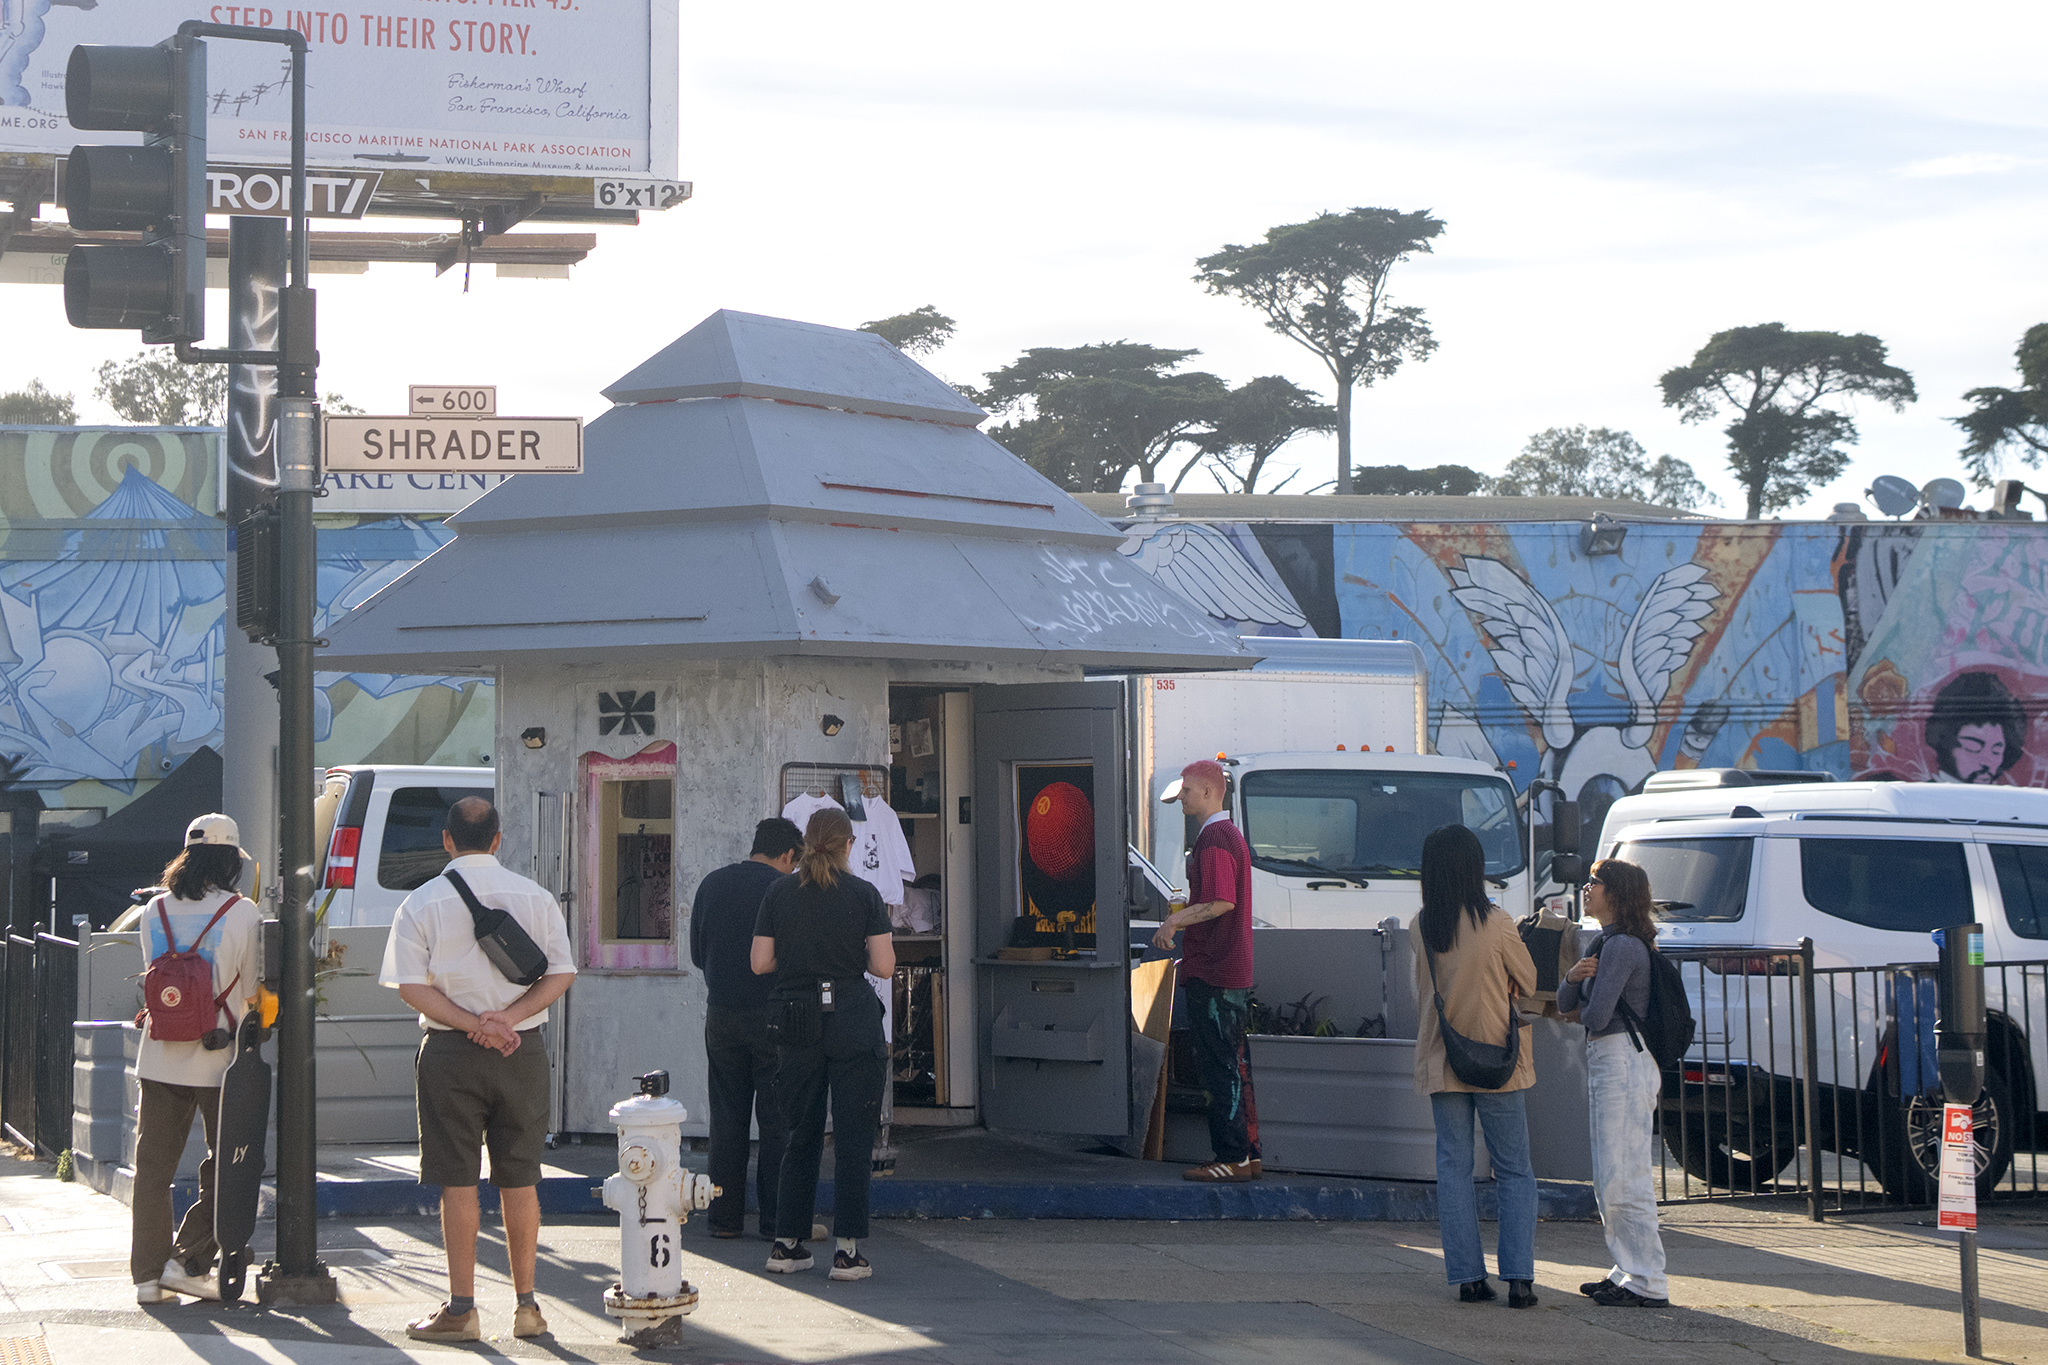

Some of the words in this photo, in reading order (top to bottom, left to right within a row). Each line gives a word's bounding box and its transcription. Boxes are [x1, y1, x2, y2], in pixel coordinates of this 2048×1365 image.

[286, 10, 348, 45] INTO
[360, 14, 436, 50] THEIR
[449, 19, 537, 56] STORY.
[447, 73, 531, 93] Fisherman's
[536, 77, 588, 98] Wharf
[447, 96, 478, 112] San
[480, 98, 551, 118] Francisco,
[556, 101, 631, 122] California
[238, 128, 267, 140] SAN
[273, 130, 352, 144] FRCISCO
[358, 134, 423, 148] MARITIME
[430, 138, 498, 152] NATIONAL
[503, 142, 536, 154] PARK
[541, 144, 631, 158] ASSOCIATION
[442, 390, 487, 411] 600
[362, 428, 541, 460] SHRADER
[1156, 679, 1175, 690] 535
[1947, 1131, 1963, 1142] NO
[231, 1144, 249, 1165] LY
[650, 1233, 670, 1268] 6
